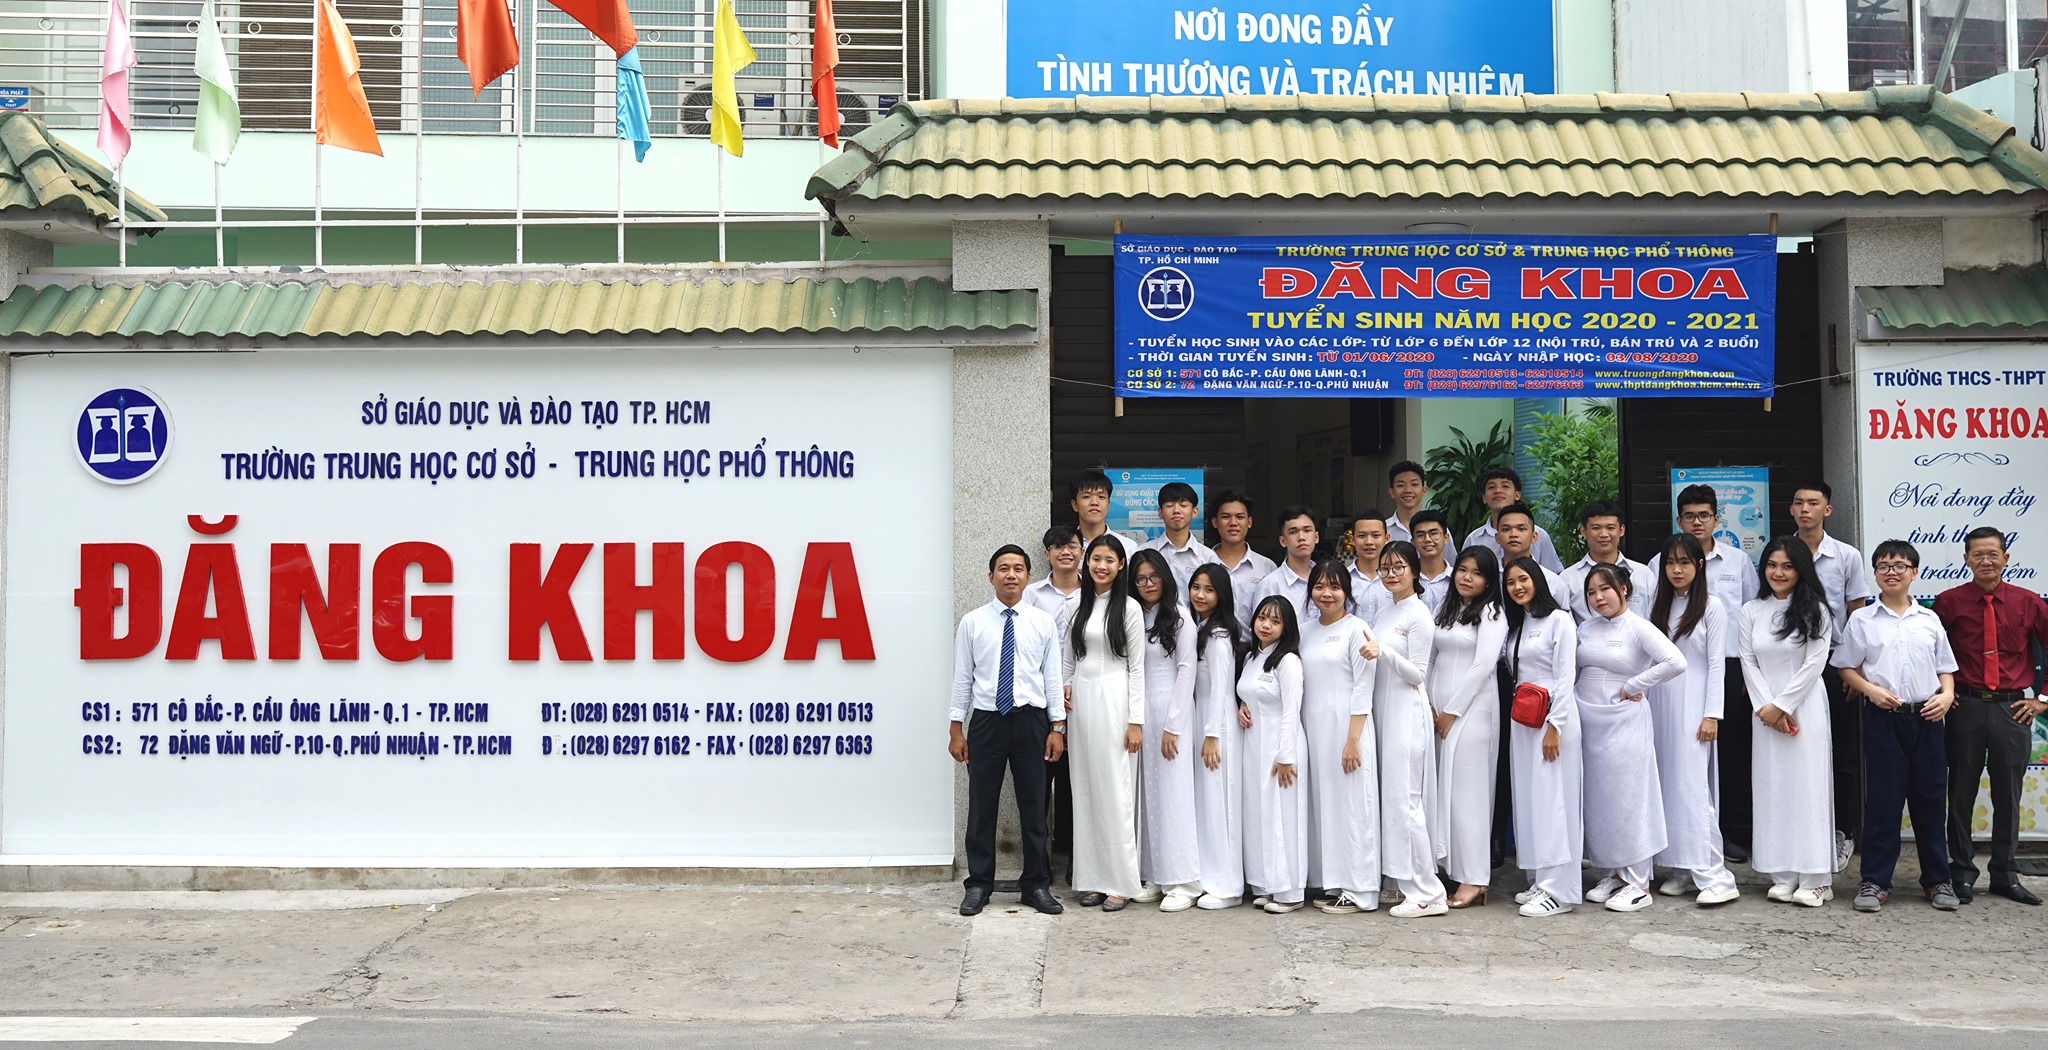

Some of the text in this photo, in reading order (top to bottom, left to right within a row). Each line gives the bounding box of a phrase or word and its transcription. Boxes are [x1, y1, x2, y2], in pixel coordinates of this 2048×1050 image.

[1174, 3, 1394, 46] NƠI ĐONG ĐẦY
[1037, 53, 1112, 92] TÌNH
[1122, 58, 1250, 95] THƯƠNG
[1259, 58, 1299, 95] VÀ
[1311, 61, 1414, 95] TRÁCH
[1121, 243, 1134, 253] SỞ
[1137, 244, 1160, 253] GIÁO
[1276, 241, 1734, 259] TRƯỜNG TRUNG HỌC CƠ SỞ & TRUNG HỌC PHỔ THÔNG
[1174, 255, 1191, 264] CHÍ
[1259, 261, 1749, 300] ĐĂNG KHOA
[1247, 303, 1759, 332] TUYỂN SINH NĂM HỌC 2020 2021
[1138, 334, 1759, 349] TUYỂN HỌC SINH VÀO CÁC LỚP: TỪ LỚP 6 ĐẾN LỚP 12 (NỘI TRÚ, BÁN TRÚ VÀ 2 BUỔI)
[1138, 350, 1174, 362] THỜI
[1178, 352, 1213, 362] GIAN
[1217, 348, 1267, 362] TUYỂN
[1317, 350, 1339, 363] TỪ
[1341, 352, 1435, 363] 01/06/2020
[1473, 351, 1699, 364] NGÀY NHẬP HỌC: 03/08/2020
[1127, 368, 1144, 378] CƠ
[1146, 367, 1163, 378] SỞ
[1166, 369, 1177, 378] 1:
[1180, 369, 1201, 379] 571
[1203, 367, 1219, 378] CÔ
[1264, 366, 1286, 378] CẦU
[1289, 366, 1311, 378] ÔNG
[1404, 369, 1424, 378] ĐT:
[1595, 369, 1735, 380] www.truongdangkhoa.com
[1873, 367, 1943, 387] TRƯỜNG
[1947, 370, 1991, 386] THCS
[1126, 379, 1143, 389] CƠ
[1146, 378, 1163, 389] SỞ
[1165, 381, 1177, 389] 2:
[1181, 381, 1195, 389] 72
[1203, 378, 1232, 390] ĐẶNG
[1236, 379, 1257, 389] VĂN
[1352, 379, 1389, 391] NHUẬN
[1404, 380, 1424, 389] ĐT:
[362, 393, 711, 430] SỞ GIÁO DỤC VÀ ĐÀO TẠO TP. HCM
[1869, 399, 2048, 440] ĐĂNG KHOA
[221, 438, 854, 485] TRƯỜNG TRUNG HỌC CƠ SỞ TRUNG HỌC PHỔ THÔNG
[1888, 482, 2037, 517] Nơi đong đầy
[1907, 525, 1948, 543] tình
[1920, 562, 2038, 582] trách iệm
[74, 514, 877, 663] ĐĂNG KHOA
[131, 703, 158, 722] 571
[168, 697, 188, 722] CÔ
[253, 695, 283, 722] CẦU
[290, 698, 321, 722] ÔNG
[541, 703, 567, 723] ĐT:
[571, 702, 607, 724] (028)
[613, 703, 647, 723] 6291
[653, 703, 689, 723] 0514
[750, 702, 789, 724] (028)
[797, 703, 831, 722] 6291
[838, 702, 873, 722] 0513
[140, 735, 158, 754] 72
[169, 730, 210, 760] ĐẶNG
[216, 730, 245, 754] VĂN
[386, 732, 438, 760] NHUẬN
[571, 735, 609, 756] (028)
[613, 736, 650, 755] 6297
[654, 736, 690, 755] 6162
[749, 734, 789, 756] (028)
[793, 736, 831, 755] 6297
[835, 735, 873, 755] 6363
